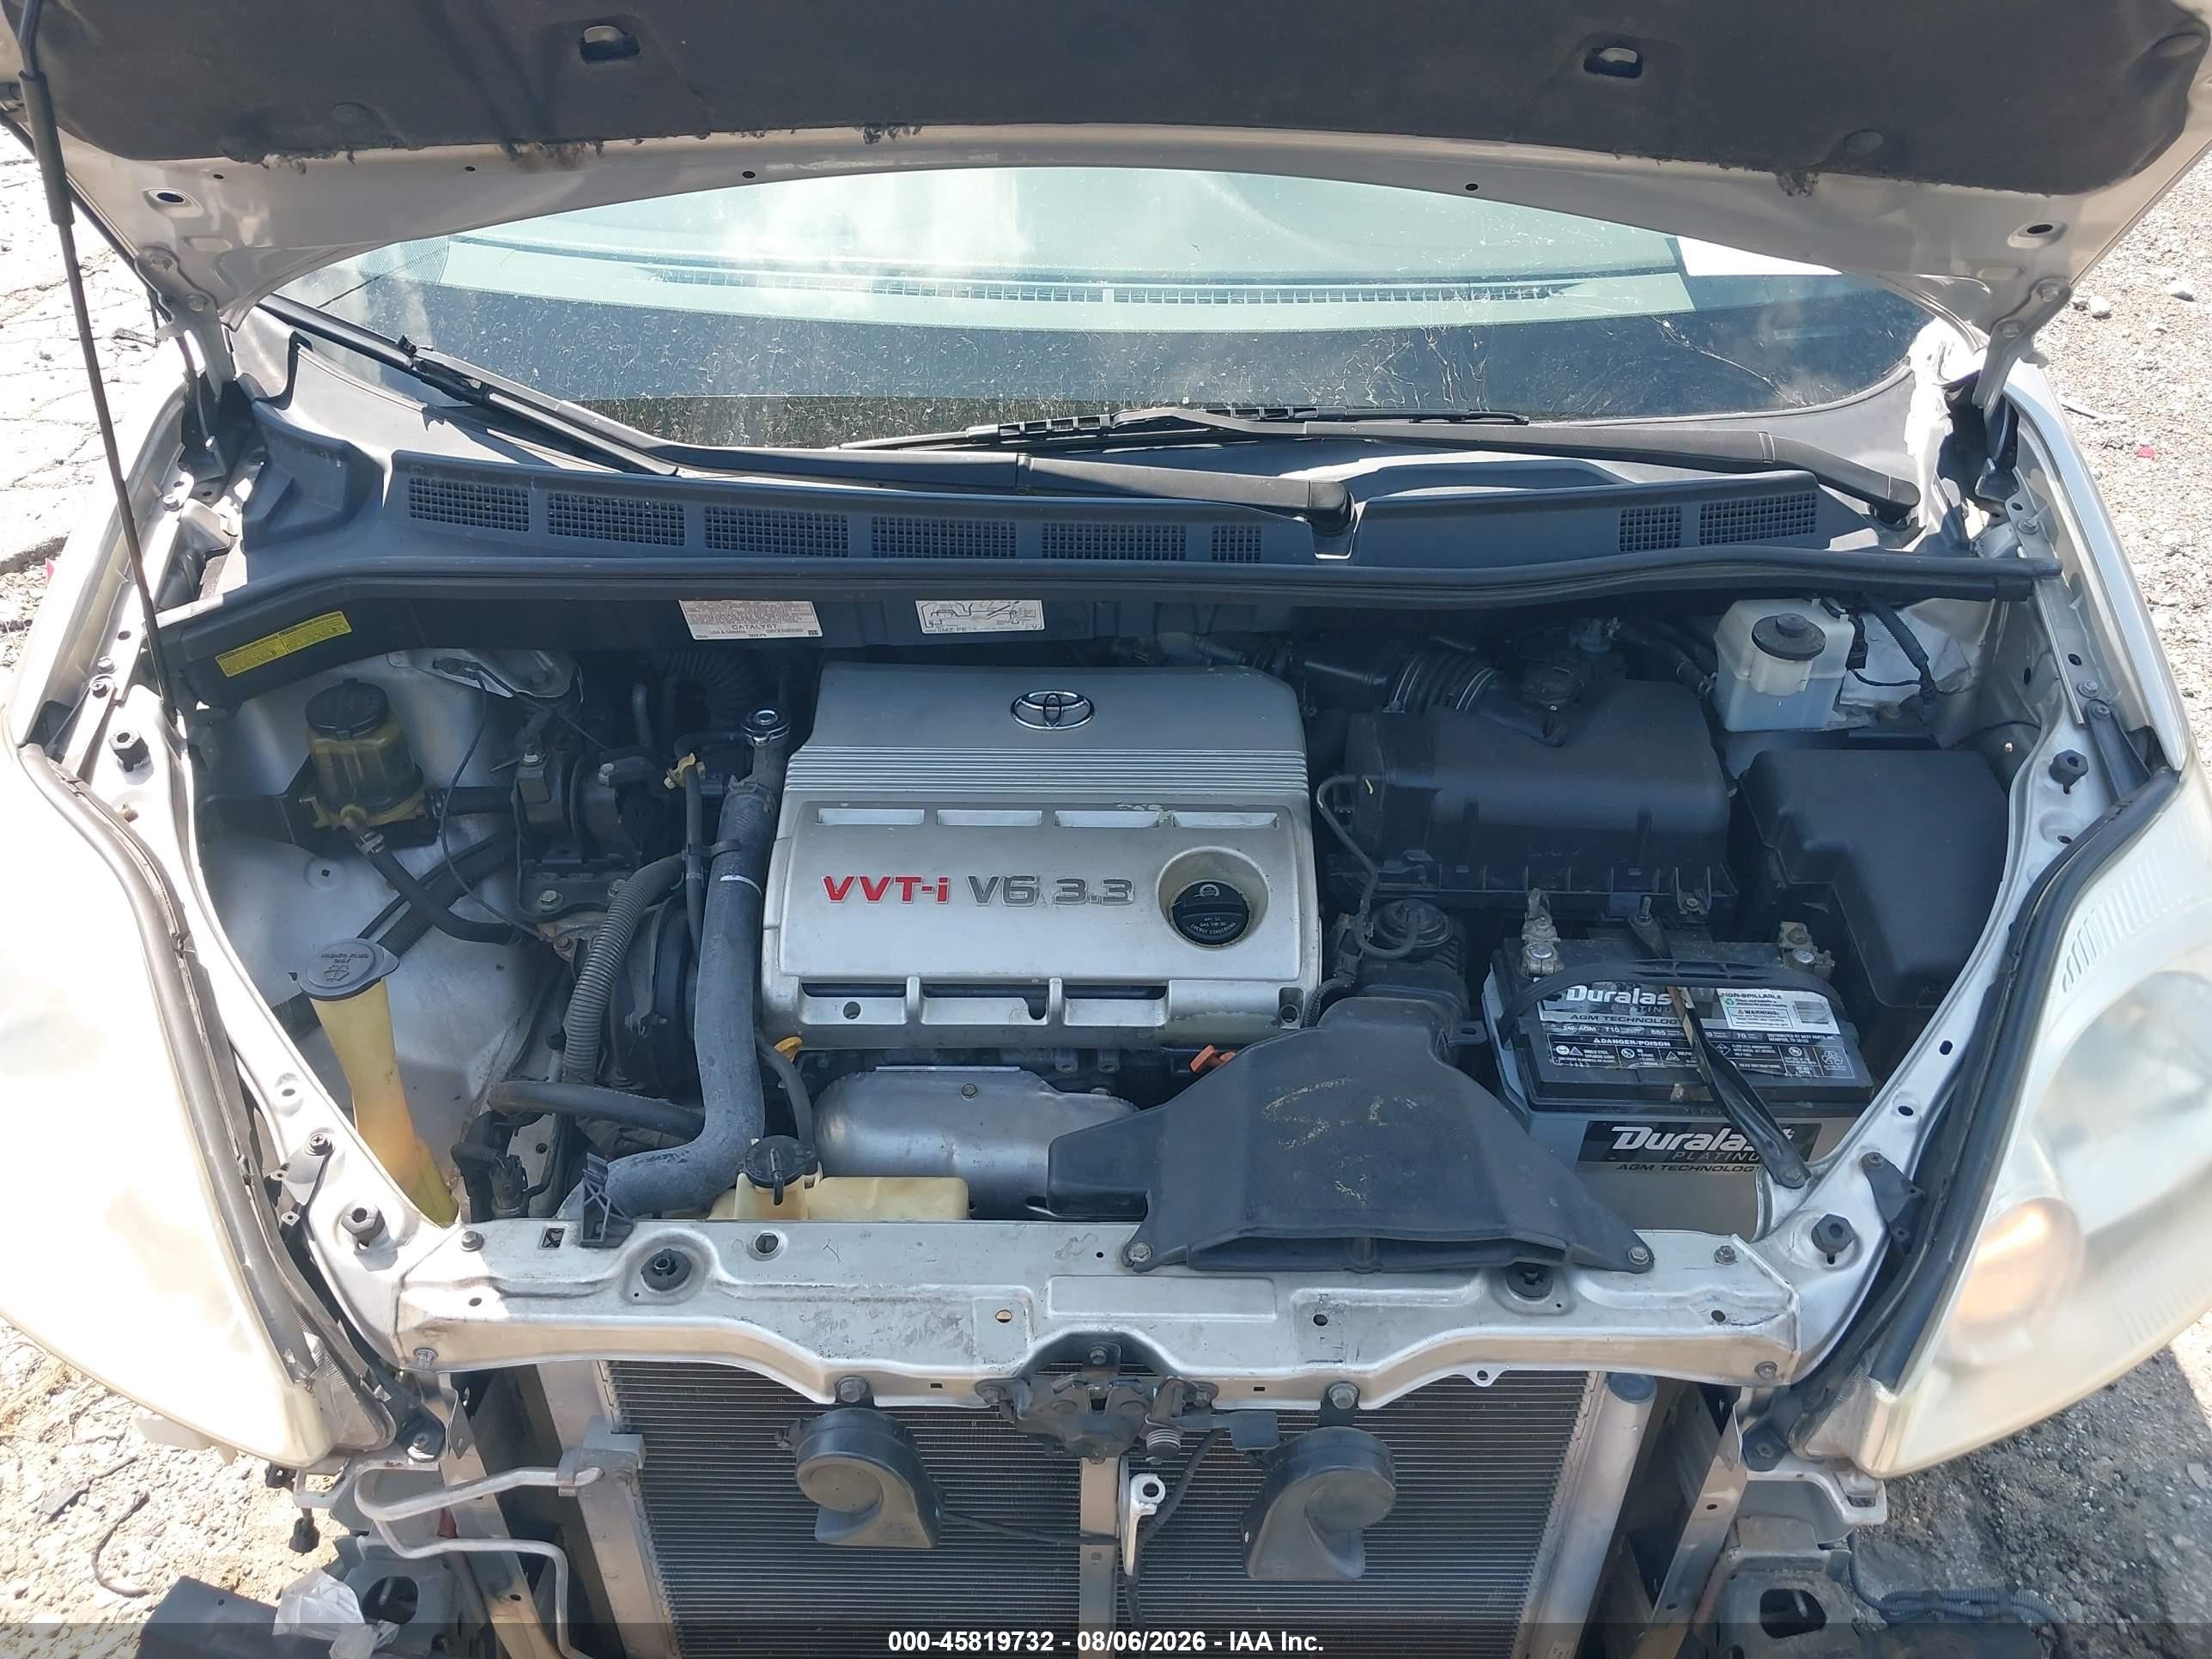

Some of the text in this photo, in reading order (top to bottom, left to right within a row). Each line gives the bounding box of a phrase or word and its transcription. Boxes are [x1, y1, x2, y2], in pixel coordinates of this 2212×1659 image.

[822, 875, 1134, 907] VVT-i V6 3.3
[1565, 984, 1673, 1006] Duralas
[1611, 1004, 1673, 1013] PLATINU
[1673, 1151, 1759, 1161] PLATINU
[1661, 1164, 1759, 1173] TECHNOLOG
